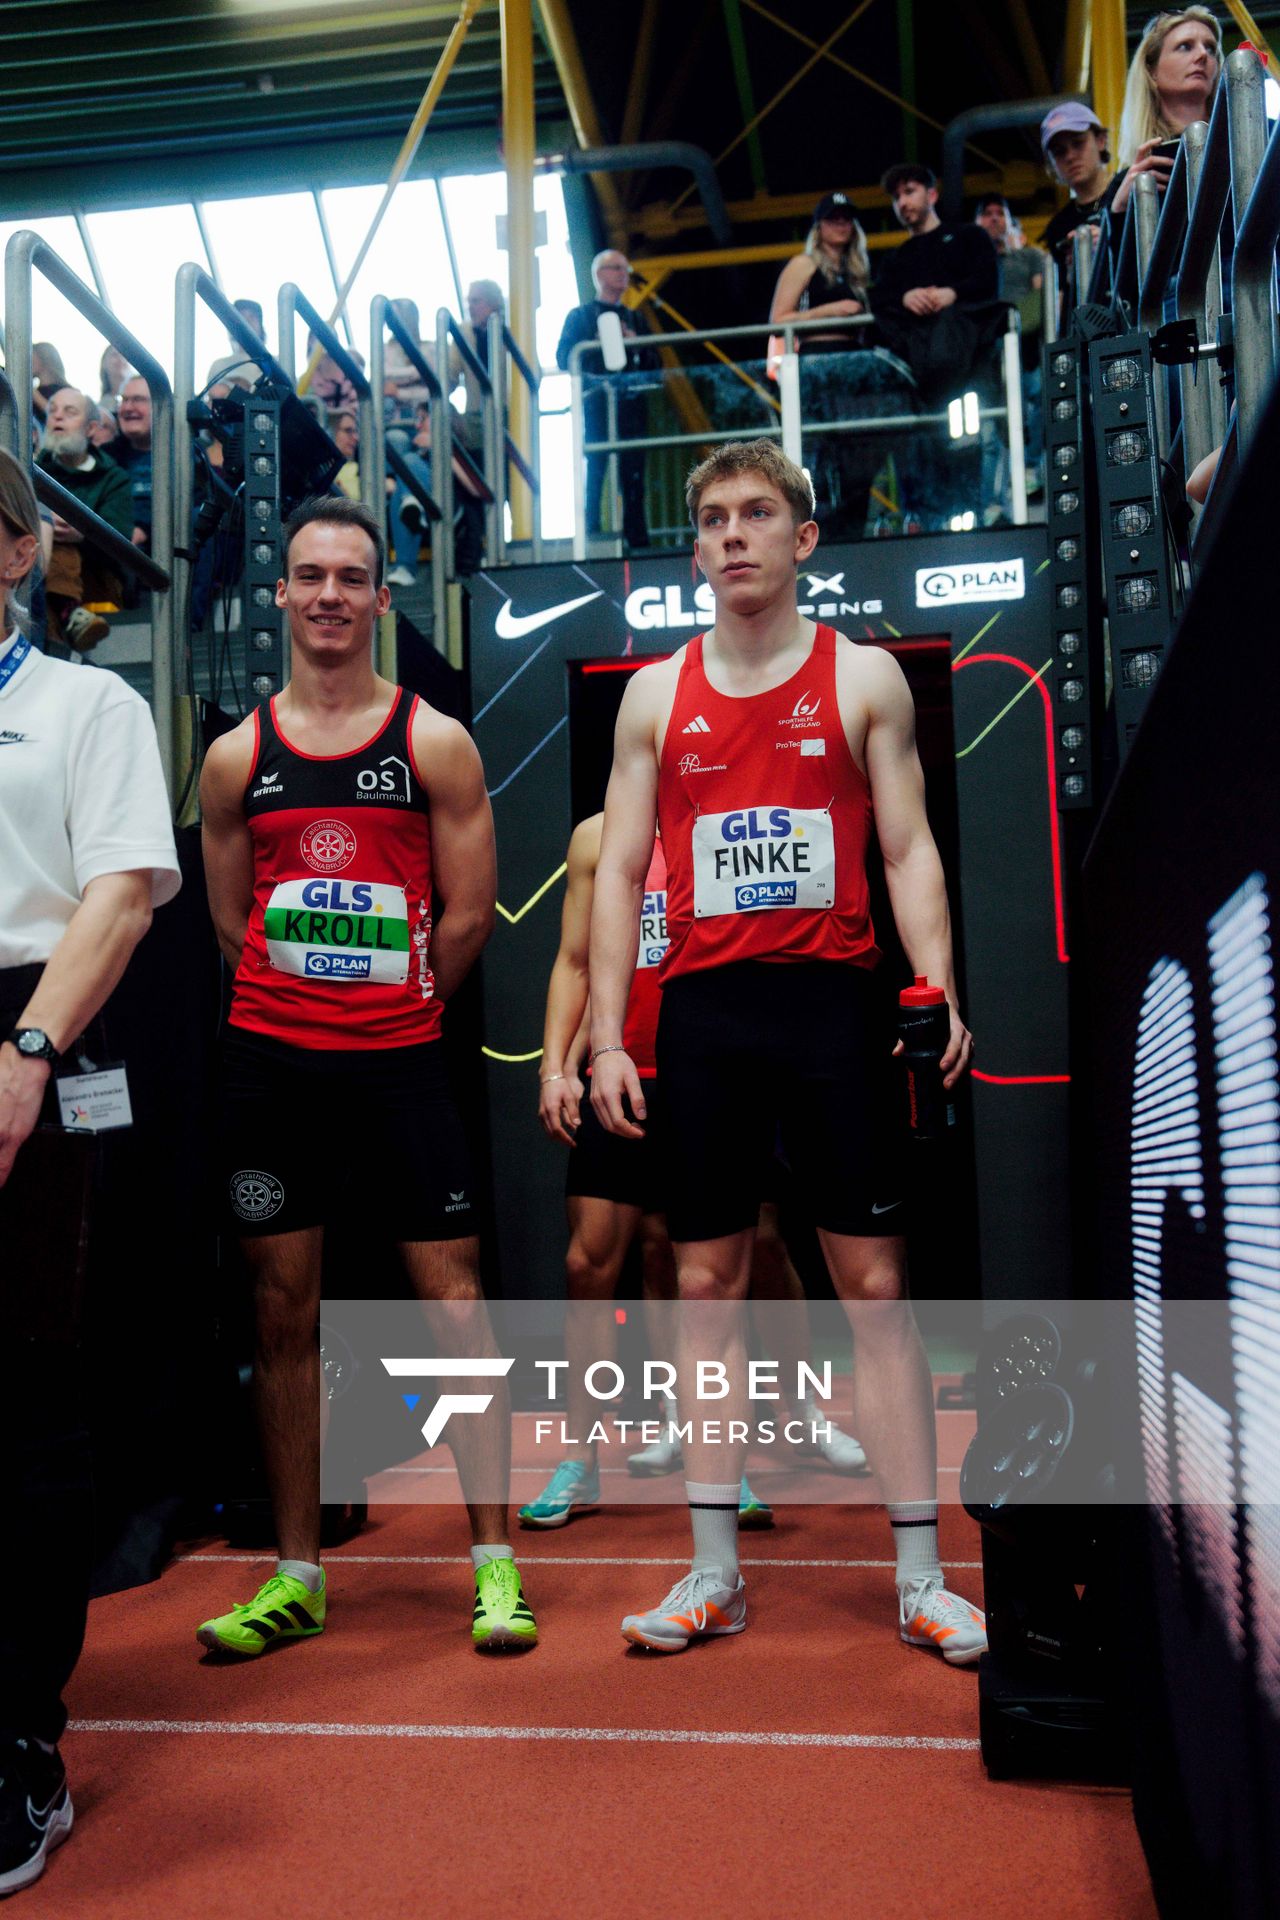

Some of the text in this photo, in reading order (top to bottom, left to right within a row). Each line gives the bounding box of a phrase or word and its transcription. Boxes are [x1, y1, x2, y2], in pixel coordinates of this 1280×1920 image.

[961, 570, 1018, 587] PLAN
[797, 600, 883, 617] PENG
[778, 716, 814, 726] SPORTHILFE
[791, 721, 821, 729] EMSLAND
[357, 770, 396, 791] OS
[253, 784, 284, 798] erima
[356, 791, 405, 802] BauImmo
[714, 842, 811, 879] FINKE
[758, 886, 794, 897] PLAN
[641, 893, 667, 915] GL
[284, 911, 392, 950] KROLL
[332, 958, 369, 971] PLAN
[445, 1202, 471, 1213] erima
